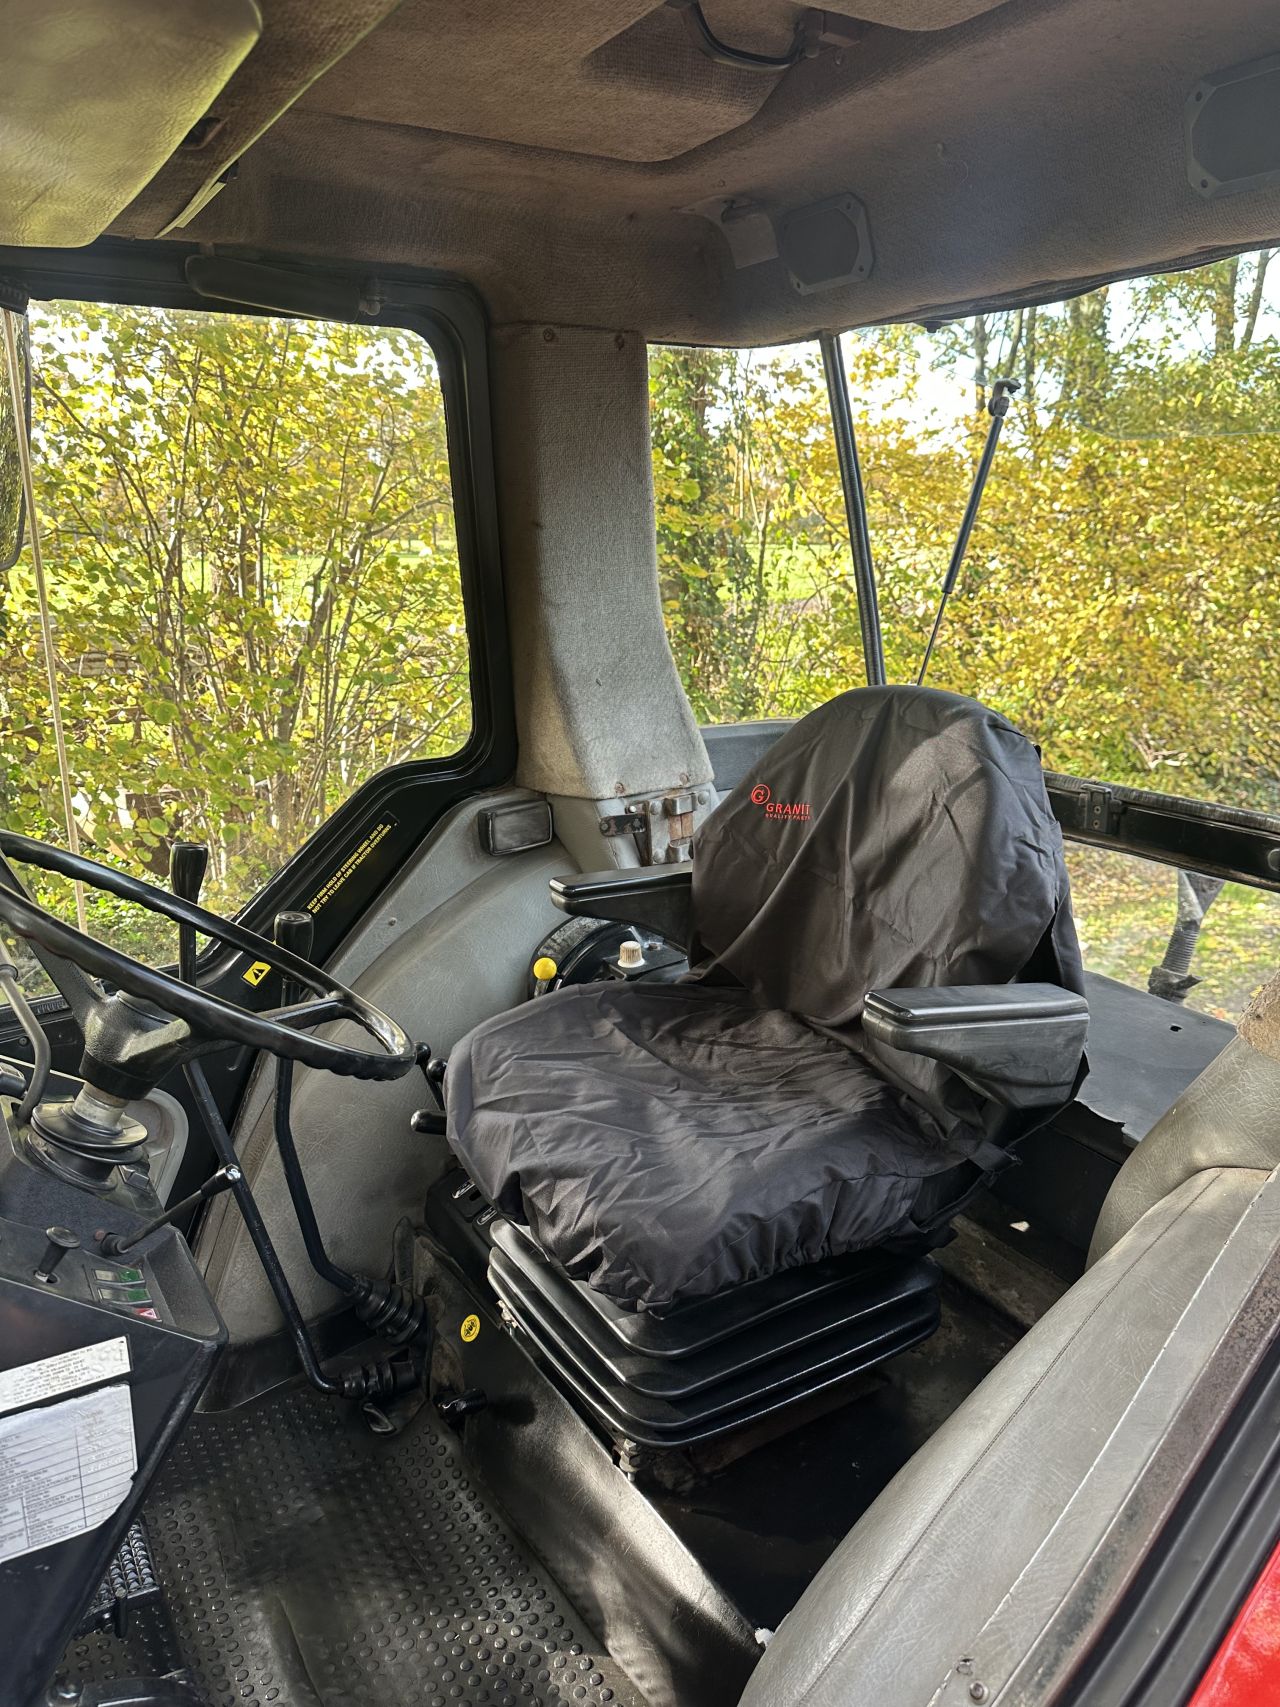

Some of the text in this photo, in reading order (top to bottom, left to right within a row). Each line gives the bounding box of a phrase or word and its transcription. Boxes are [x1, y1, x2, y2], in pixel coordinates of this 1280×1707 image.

[766, 803, 811, 814] GRANIT
[307, 898, 318, 909] KEEP
[326, 877, 337, 888] HOLD
[341, 852, 358, 871] STEERING
[357, 840, 370, 853] WHEEL
[312, 903, 321, 913] NOT
[320, 895, 328, 904] TRY
[334, 877, 345, 890] LEAVE
[344, 869, 352, 878] CAB
[355, 847, 371, 865] TRACTOR
[370, 824, 391, 848] OVERTURNS
